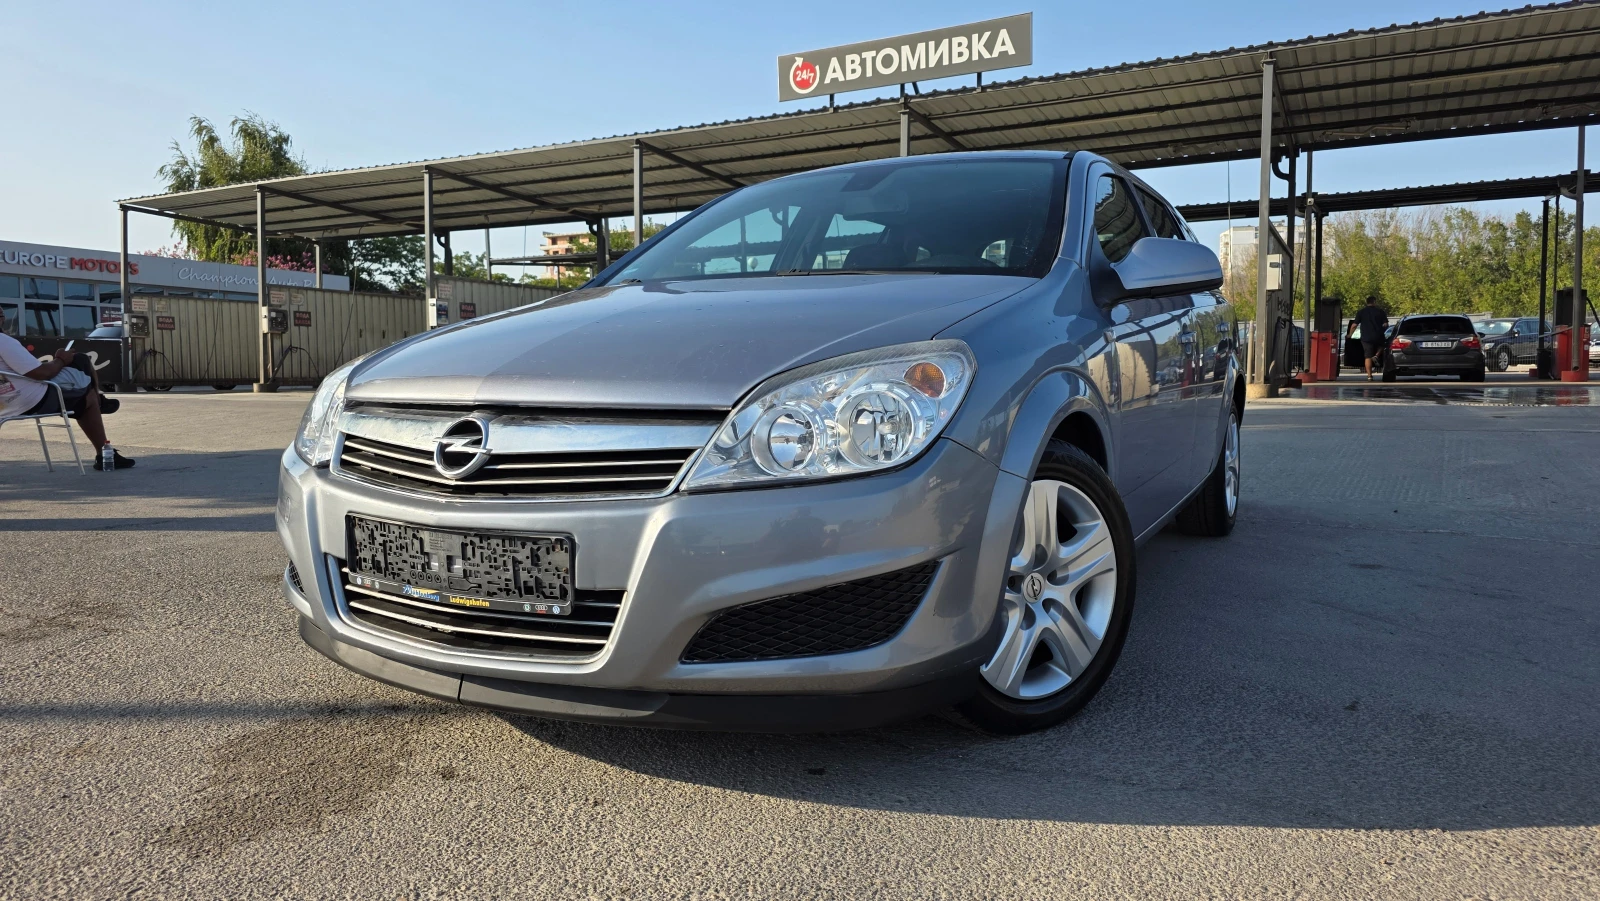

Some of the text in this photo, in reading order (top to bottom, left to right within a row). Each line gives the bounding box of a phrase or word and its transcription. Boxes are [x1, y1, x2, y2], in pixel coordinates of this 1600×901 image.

[796, 28, 1016, 84] 24/7 АВТОМИВКА
[178, 267, 259, 287] Champion
[449, 595, 490, 607] Ludwigshafen
